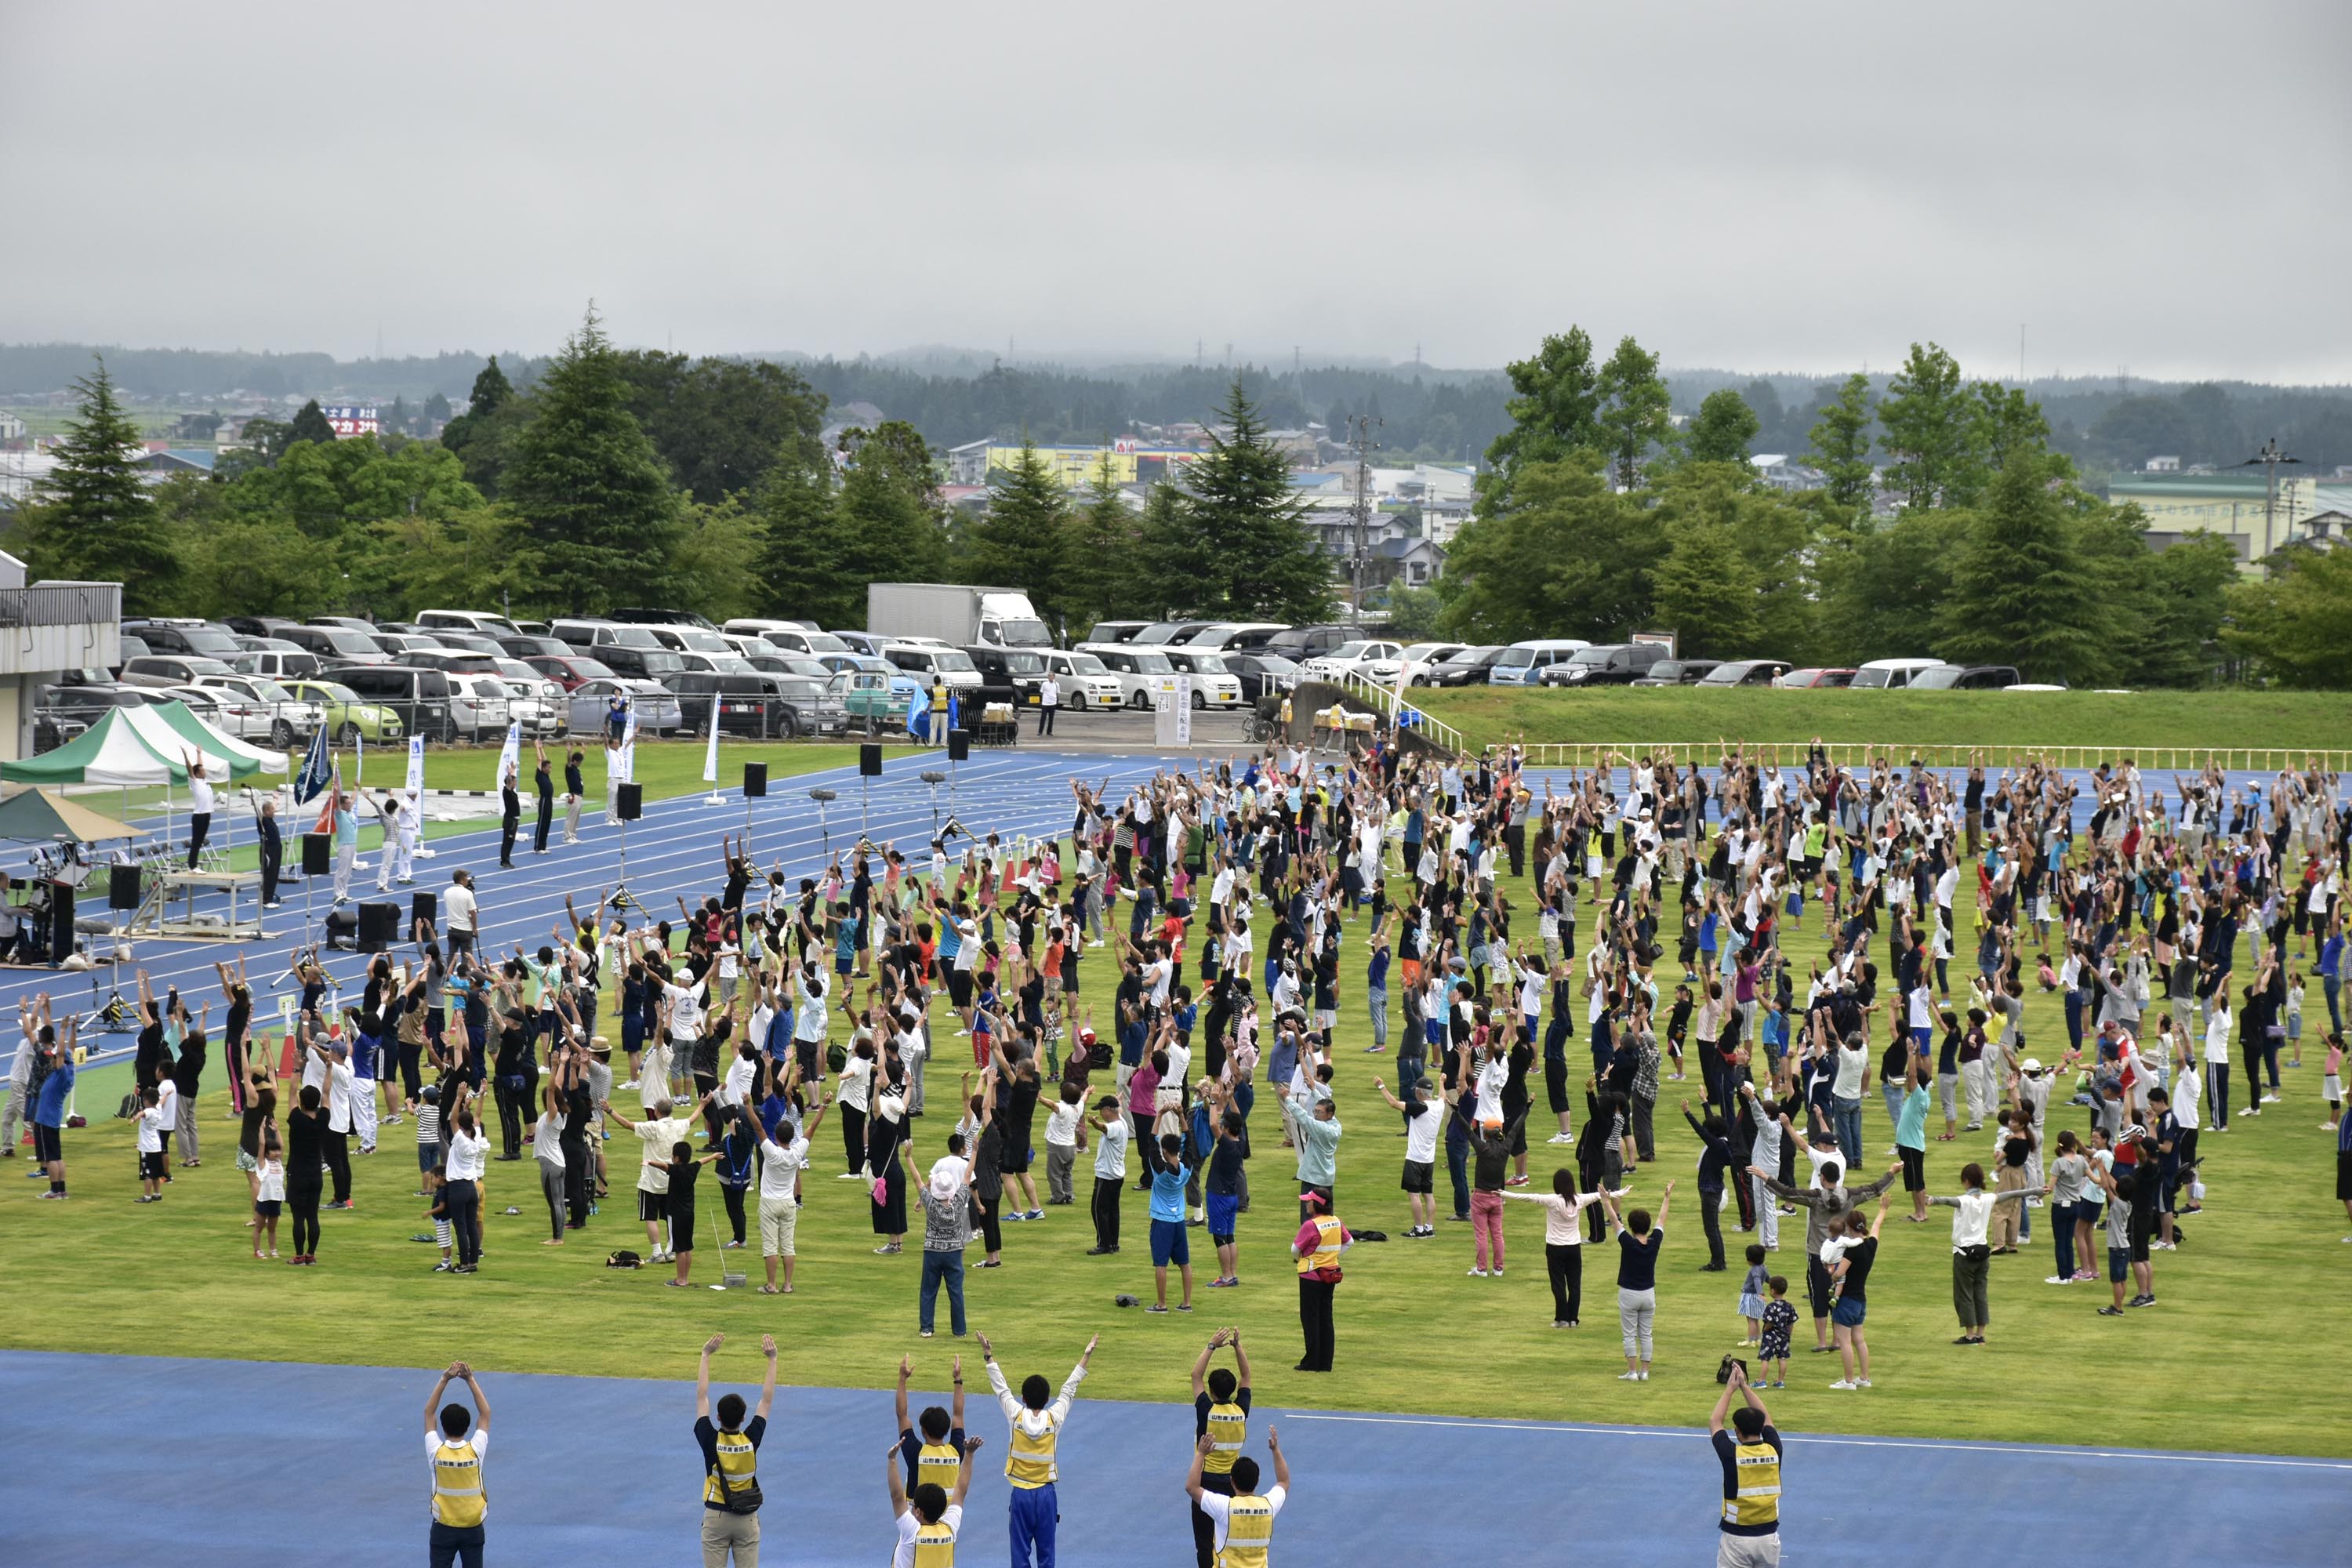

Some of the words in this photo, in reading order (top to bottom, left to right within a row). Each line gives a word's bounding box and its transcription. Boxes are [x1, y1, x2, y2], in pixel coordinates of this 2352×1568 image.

[319, 407, 351, 419] 士服
[1178, 677, 1189, 740] 参加記念品配布所
